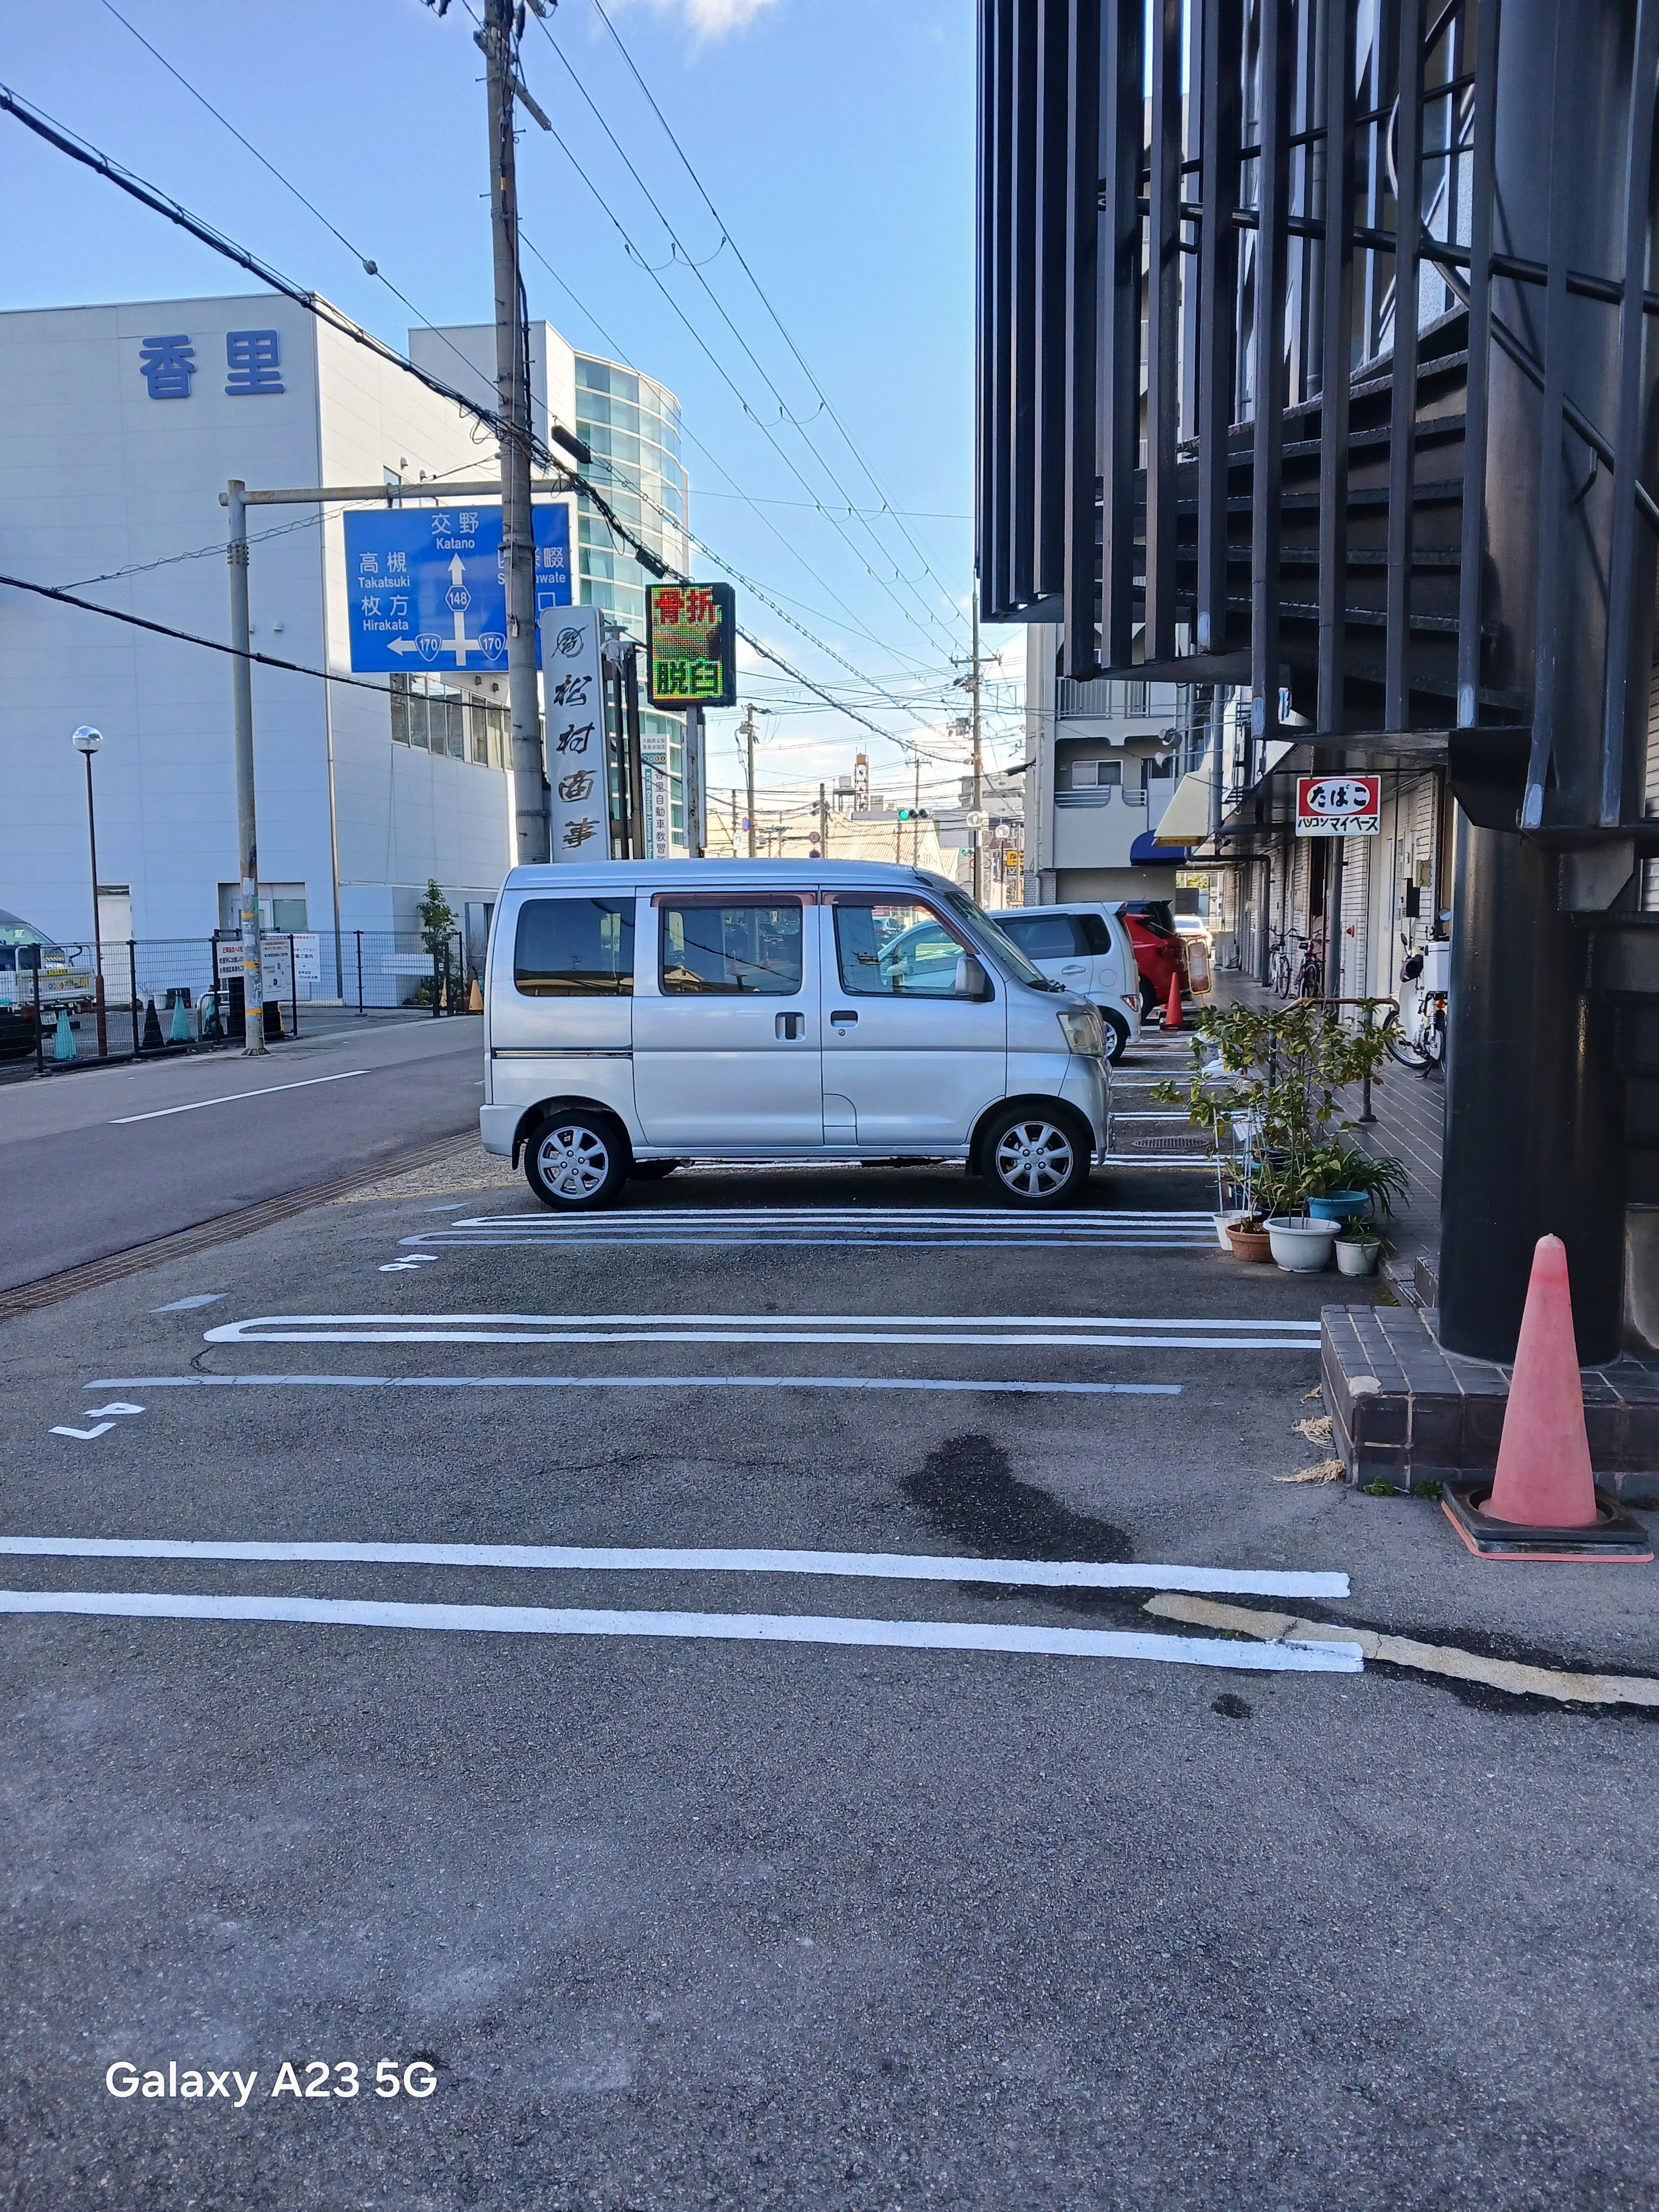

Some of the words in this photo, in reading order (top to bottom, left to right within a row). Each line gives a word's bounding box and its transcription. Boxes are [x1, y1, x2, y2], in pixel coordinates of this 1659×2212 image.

[139, 329, 285, 399] 香里
[432, 512, 478, 535] 交野
[436, 537, 475, 549] Katano
[359, 551, 406, 574] 高槻
[358, 575, 410, 588] Takatsuki
[361, 594, 409, 617] 枚方
[449, 592, 467, 605] 148
[655, 588, 717, 624] 骨折
[363, 619, 409, 631] Hirakata
[419, 639, 438, 651] 170
[483, 637, 501, 650] 170
[657, 661, 719, 694] 脱臼
[554, 674, 600, 850] 松村商事
[1310, 784, 1366, 808] たばこ
